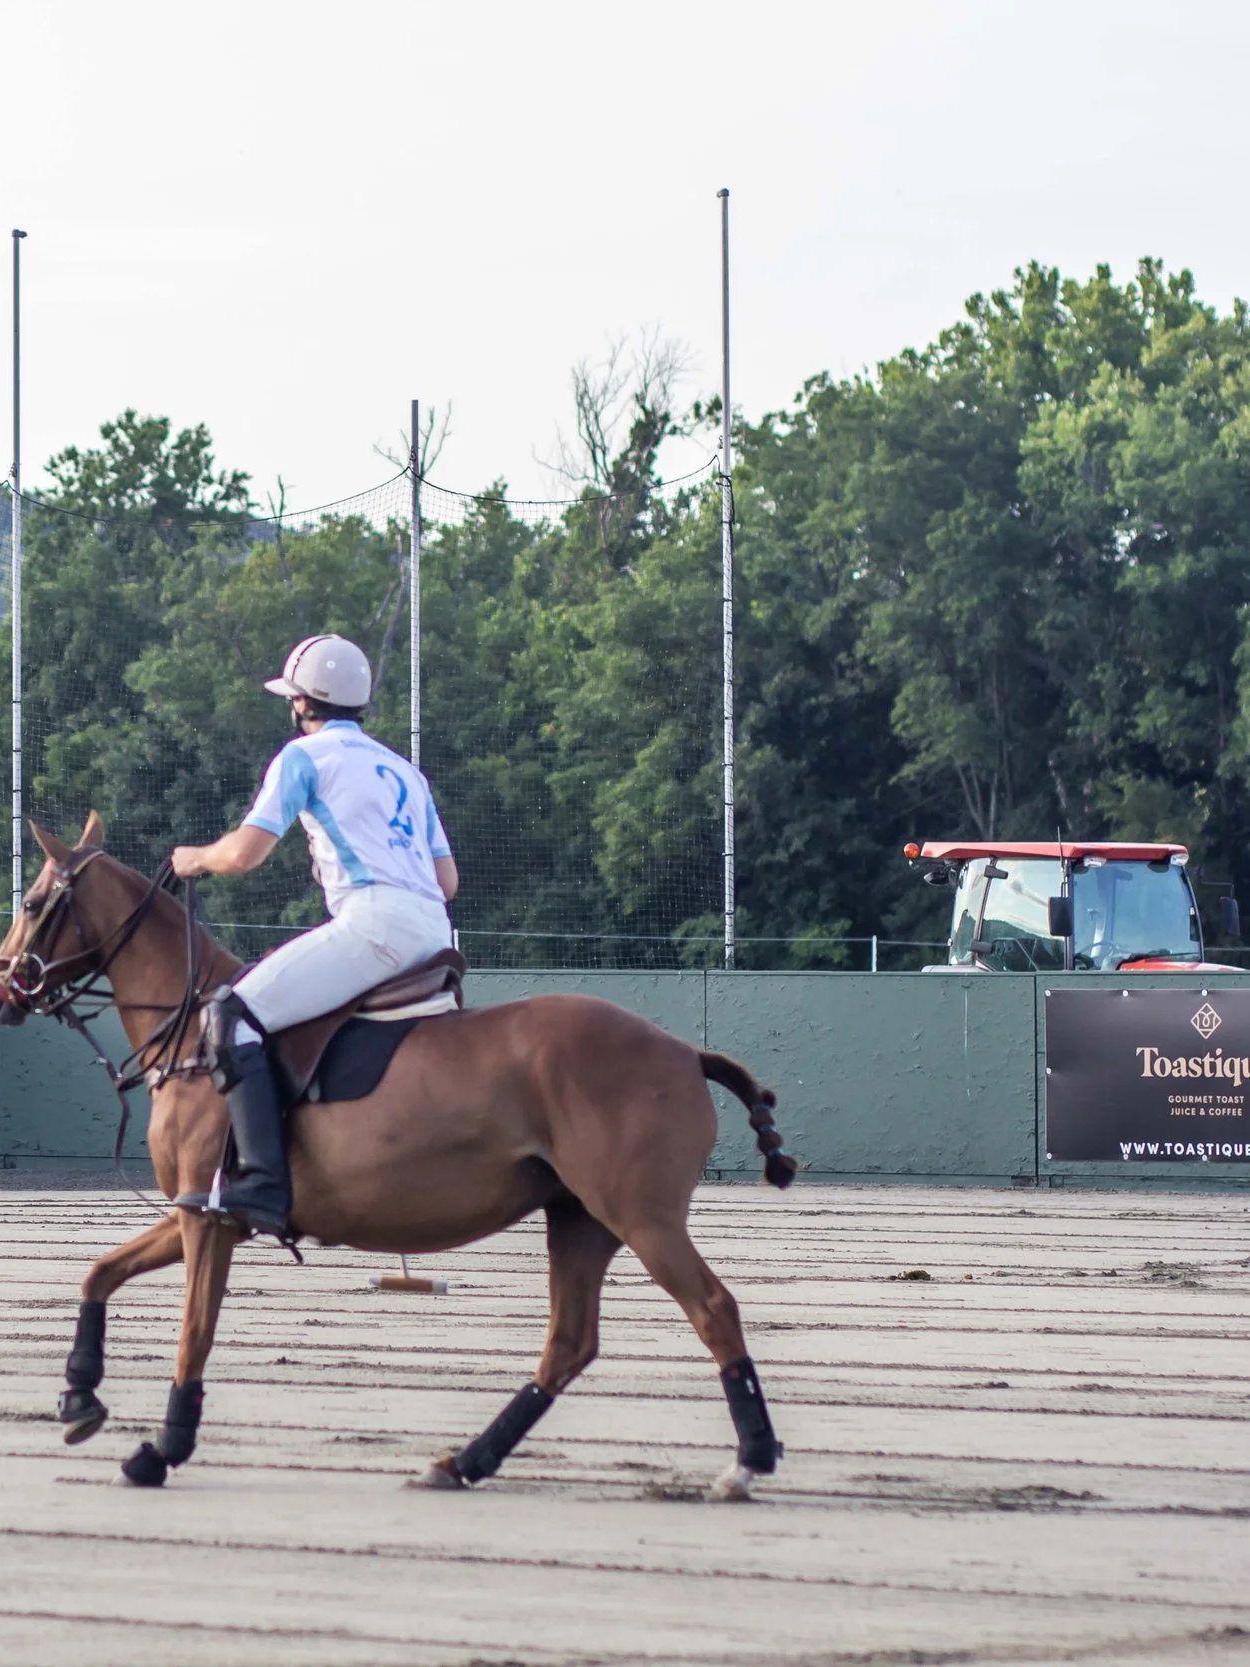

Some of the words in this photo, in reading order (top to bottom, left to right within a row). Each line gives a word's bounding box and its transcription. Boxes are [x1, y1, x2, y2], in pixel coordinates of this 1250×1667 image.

[375, 764, 414, 837] 2
[1167, 1095, 1213, 1104] GOURMET
[1216, 1095, 1245, 1104] TOAST
[1170, 1107, 1196, 1116] JUICE
[1199, 1107, 1206, 1116] &
[1208, 1107, 1243, 1117] COFFEE
[1119, 1141, 1250, 1157] WWW.TOASTIQUE
